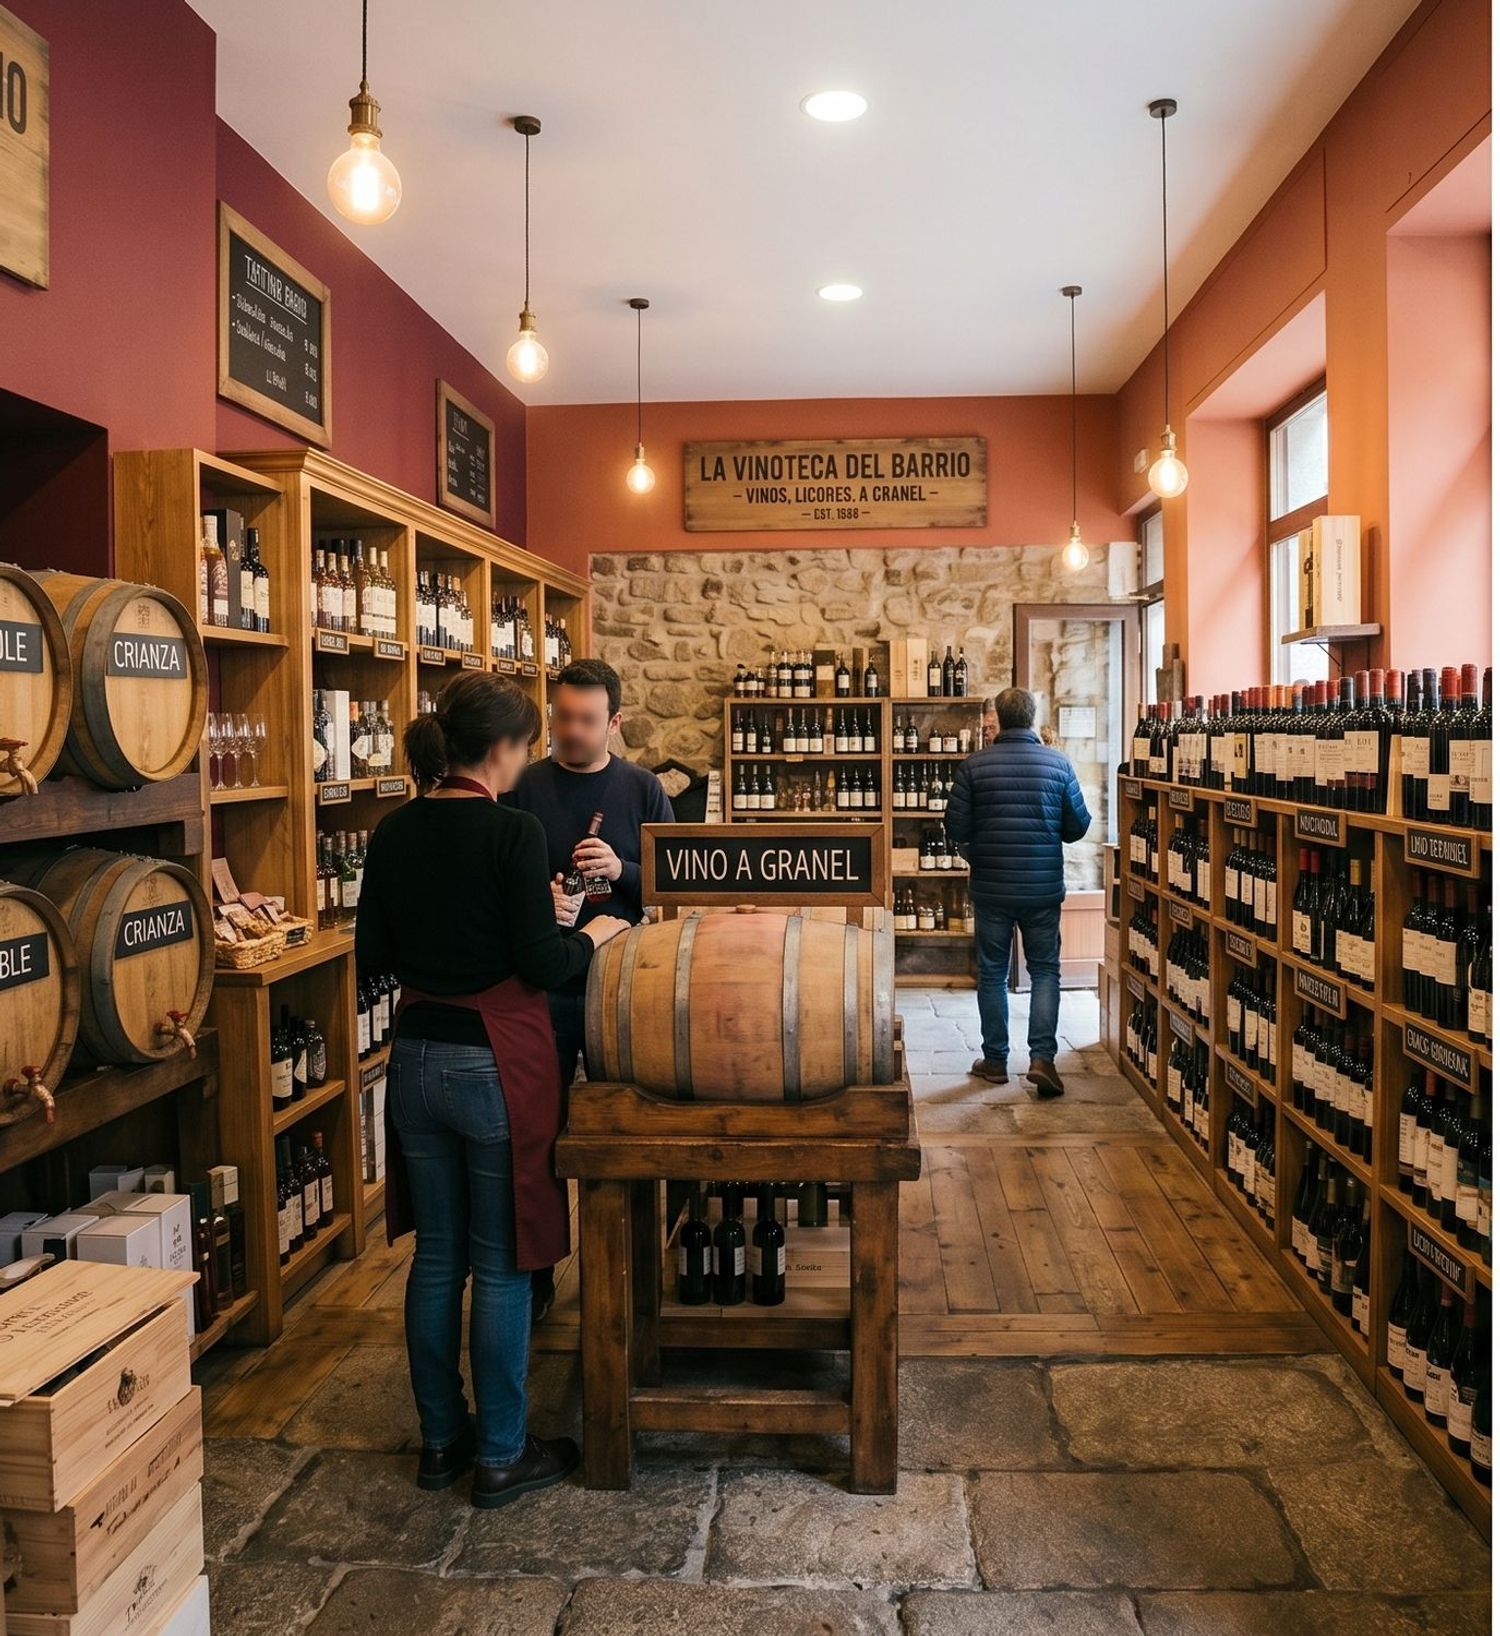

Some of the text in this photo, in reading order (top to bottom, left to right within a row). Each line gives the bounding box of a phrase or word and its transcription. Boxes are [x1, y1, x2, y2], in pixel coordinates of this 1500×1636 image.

[700, 451, 971, 482] LA VINOTECA DEL BARRIO
[746, 487, 791, 505] VINOS,
[859, 486, 869, 502] A
[813, 508, 834, 520] EST.
[113, 640, 181, 671] CRIANZA
[666, 849, 860, 881] VINO A GRANEL
[123, 909, 186, 947] CRIANZA
